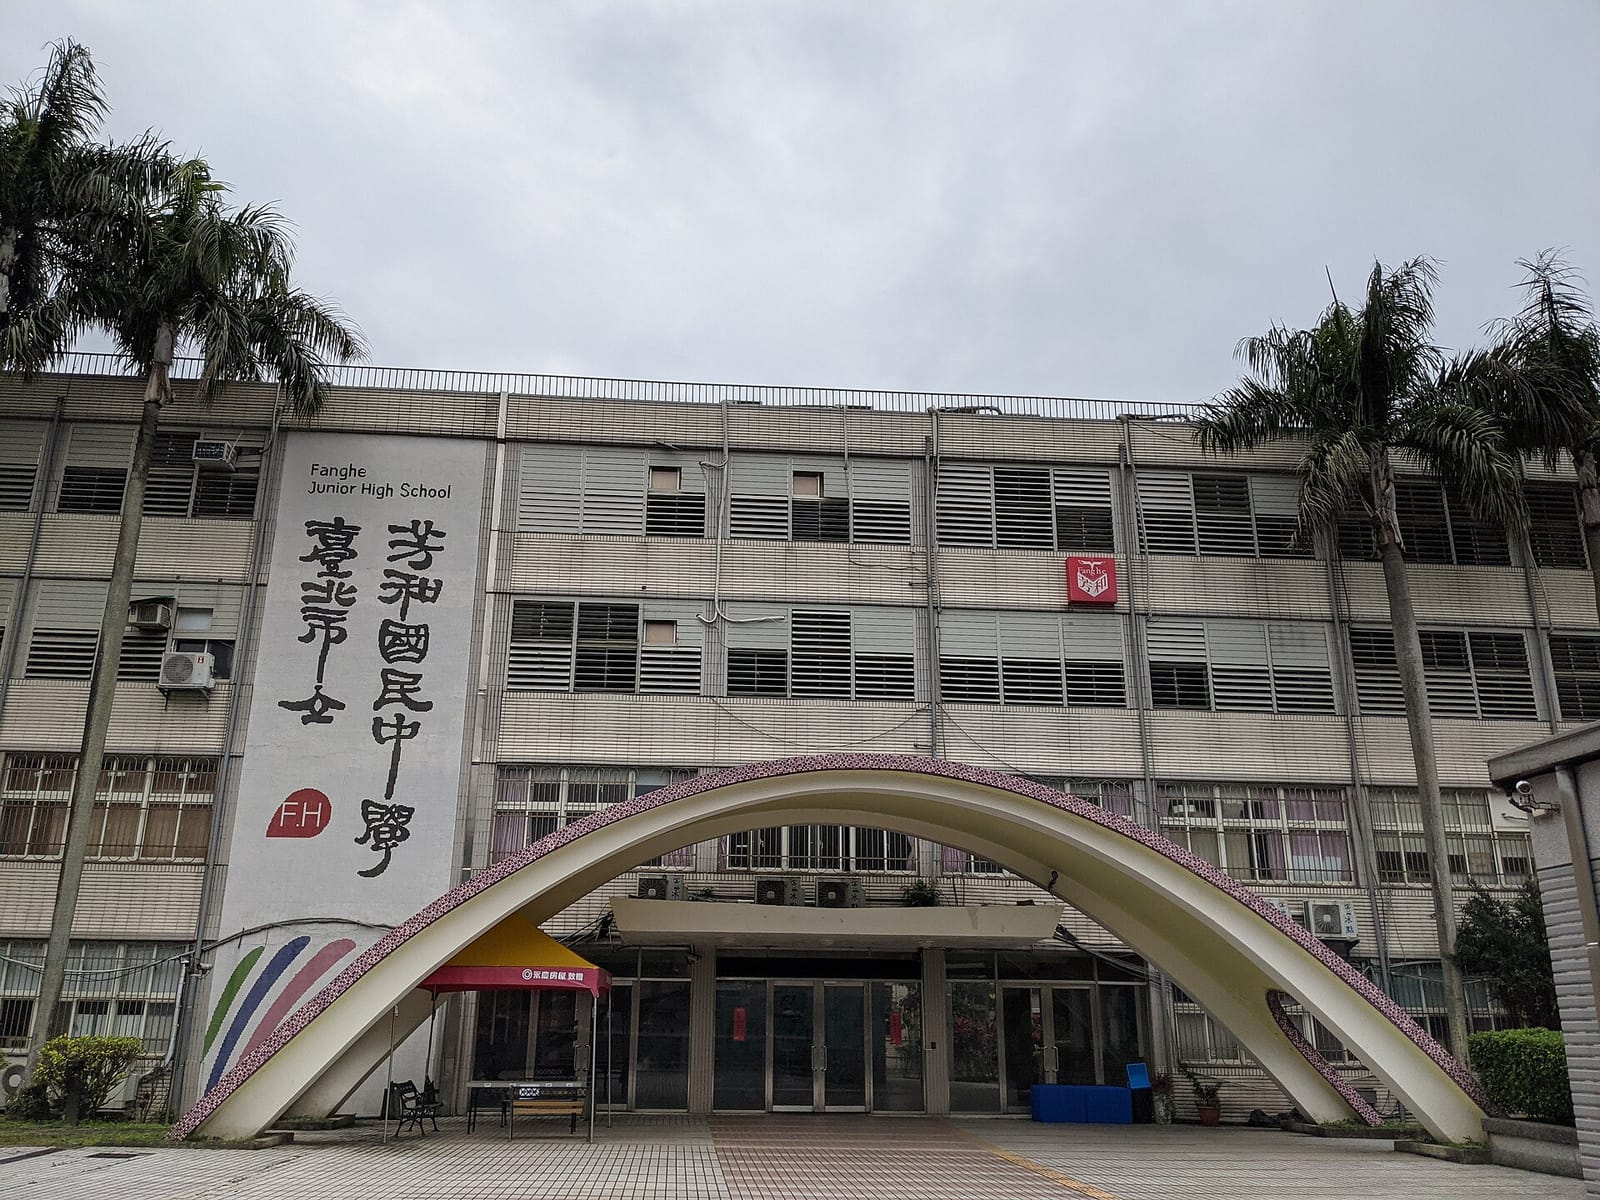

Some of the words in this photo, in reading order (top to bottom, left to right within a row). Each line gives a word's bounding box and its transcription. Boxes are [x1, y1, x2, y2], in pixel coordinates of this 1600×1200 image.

[308, 481, 357, 495] Junior
[361, 483, 394, 499] High
[400, 483, 451, 499] School
[311, 463, 367, 480] Fanghe
[278, 517, 362, 725] 臺北市立
[355, 519, 447, 879] 芳和國民中學
